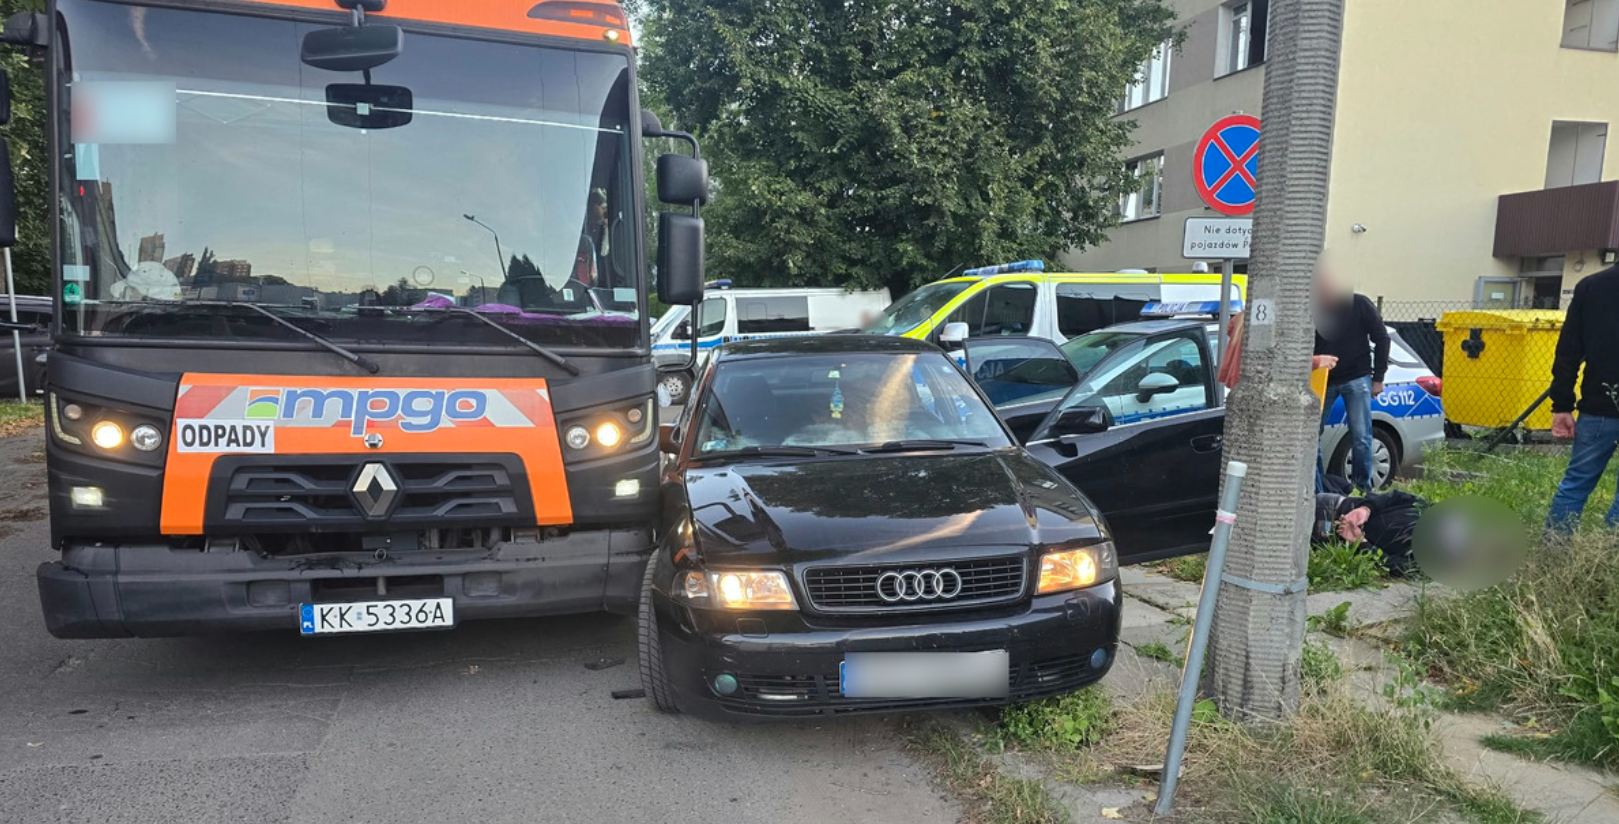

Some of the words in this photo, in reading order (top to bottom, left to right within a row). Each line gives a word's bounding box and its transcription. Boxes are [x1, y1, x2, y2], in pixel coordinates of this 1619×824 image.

[1203, 225, 1221, 234] Nie
[1255, 303, 1267, 321] 8
[1377, 391, 1415, 406] GG112
[281, 388, 488, 437] mpgo
[180, 423, 270, 448] ODPADY
[320, 605, 354, 629] KK
[366, 601, 446, 627] 5336A
